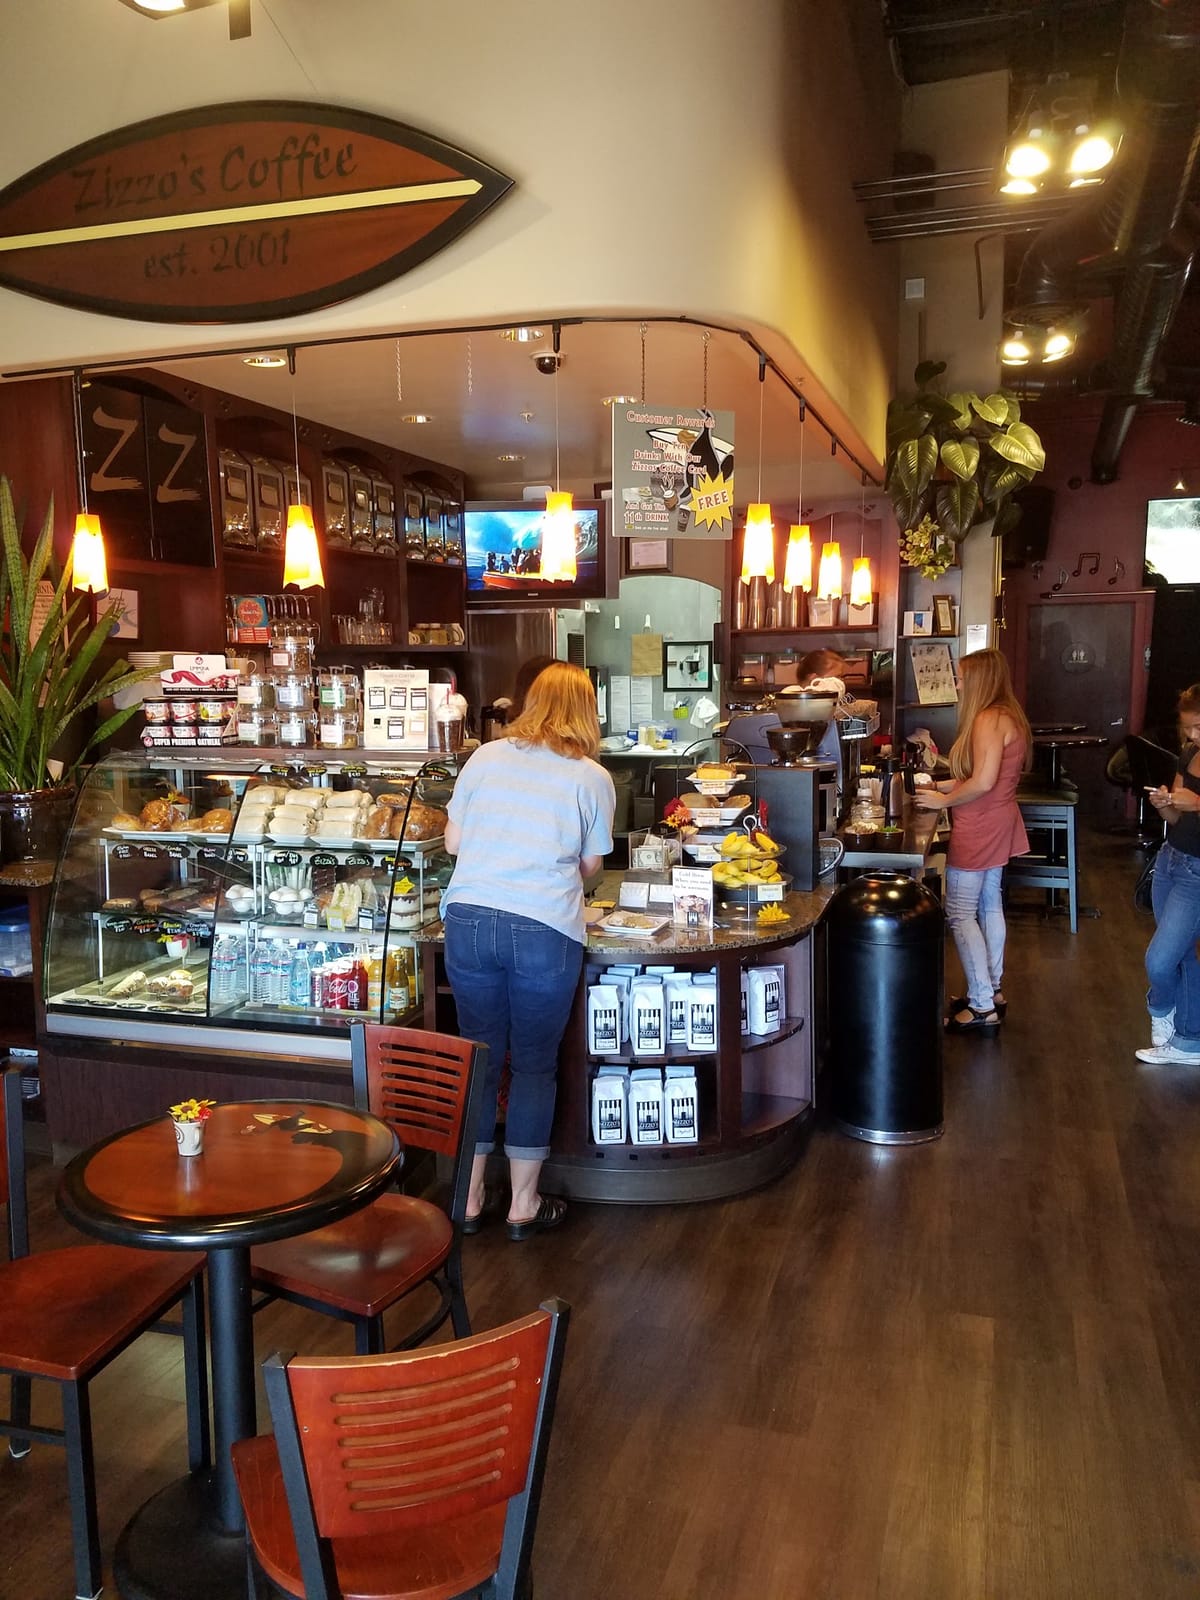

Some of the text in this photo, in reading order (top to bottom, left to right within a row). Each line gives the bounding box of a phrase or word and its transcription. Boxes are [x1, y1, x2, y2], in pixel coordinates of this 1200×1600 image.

[71, 132, 358, 213] Zizzo's Coffee
[143, 228, 290, 280] est. 2001
[626, 410, 715, 429] Customer Rewards
[652, 439, 668, 450] Buy
[633, 449, 702, 463] Drinks With Our
[659, 463, 686, 474] Coffee
[697, 490, 729, 511] FREE
[644, 512, 669, 523] DRINK
